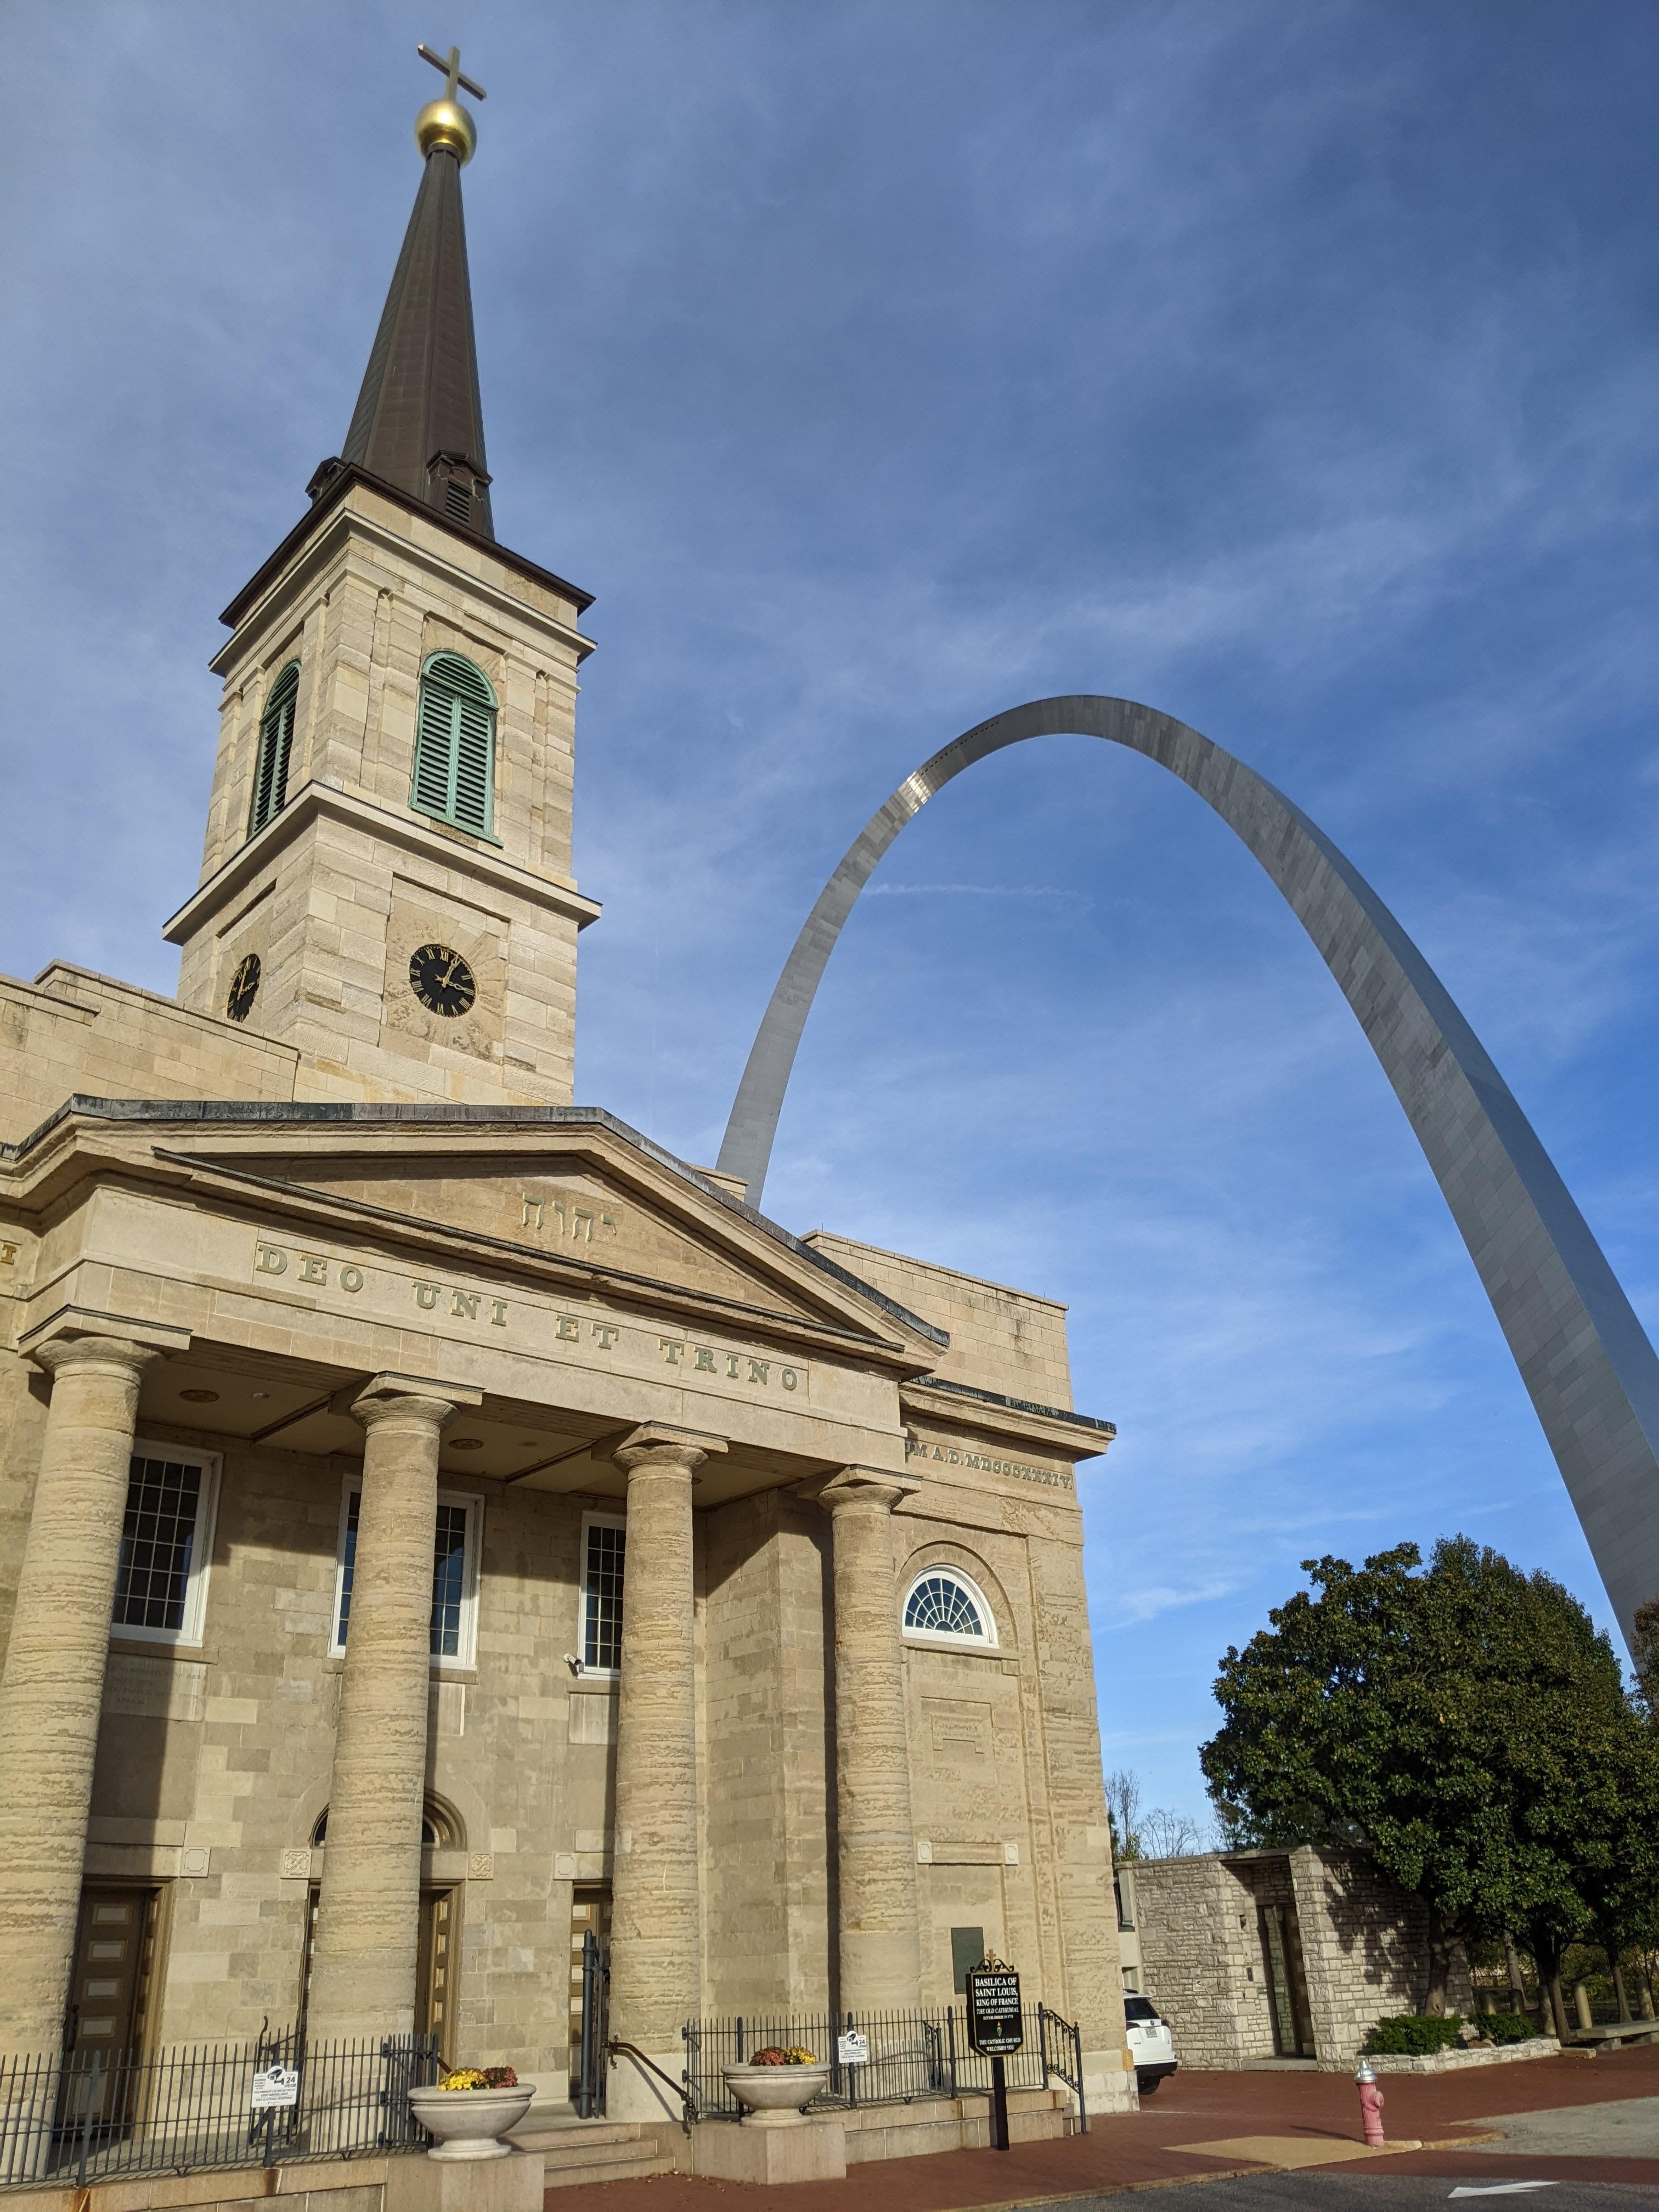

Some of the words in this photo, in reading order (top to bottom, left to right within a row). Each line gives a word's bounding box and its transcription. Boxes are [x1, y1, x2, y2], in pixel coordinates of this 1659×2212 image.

[440, 949, 449, 962] XII
[255, 1244, 364, 1293] DEO
[411, 1280, 508, 1327] UNI
[555, 1314, 619, 1350] ET
[658, 1338, 798, 1391] TRINO
[975, 1977, 1007, 1987] BASILICA
[1007, 1977, 1017, 1985] OF
[975, 1988, 996, 1997] SAINT
[997, 1987, 1018, 1997] LOUIS,
[998, 1997, 1019, 2006] FRANCE
